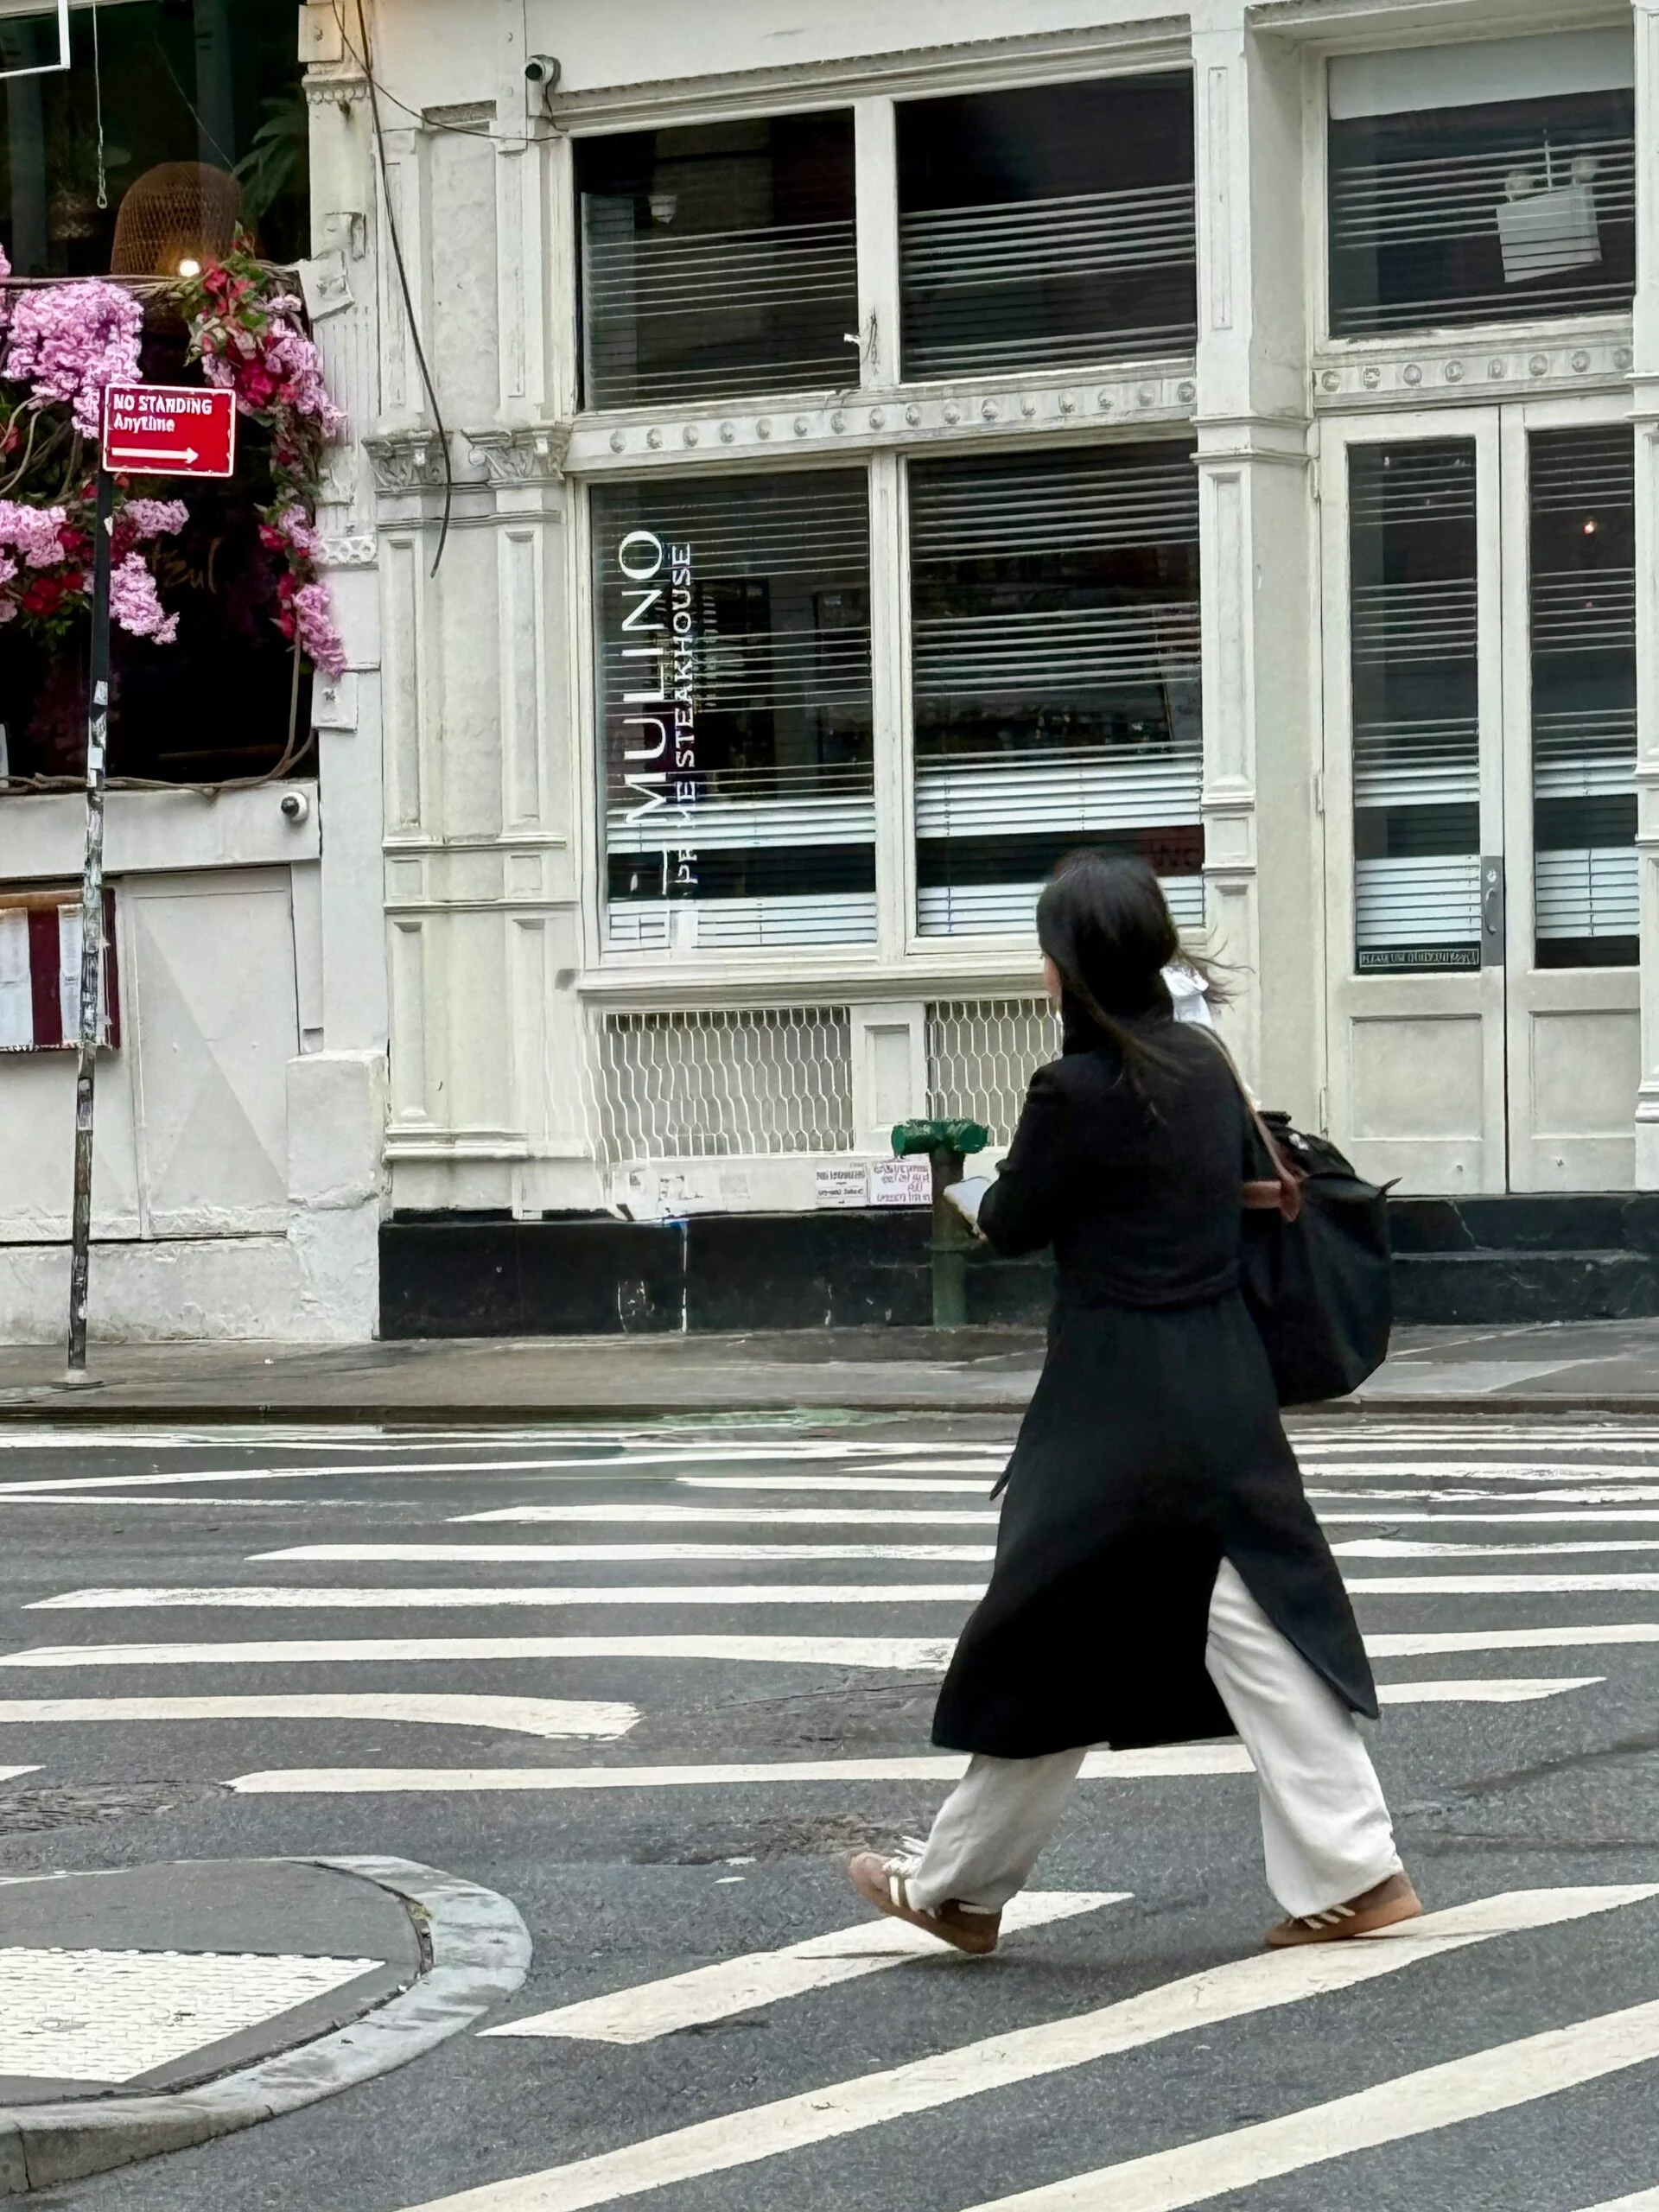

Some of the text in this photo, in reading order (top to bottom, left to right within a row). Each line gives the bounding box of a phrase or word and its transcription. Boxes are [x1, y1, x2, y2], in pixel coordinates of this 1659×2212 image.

[113, 394, 213, 415] NO STANDING
[113, 413, 175, 434] Anytime
[619, 531, 667, 823] MULINO
[671, 542, 696, 767] STEAKHOUSE
